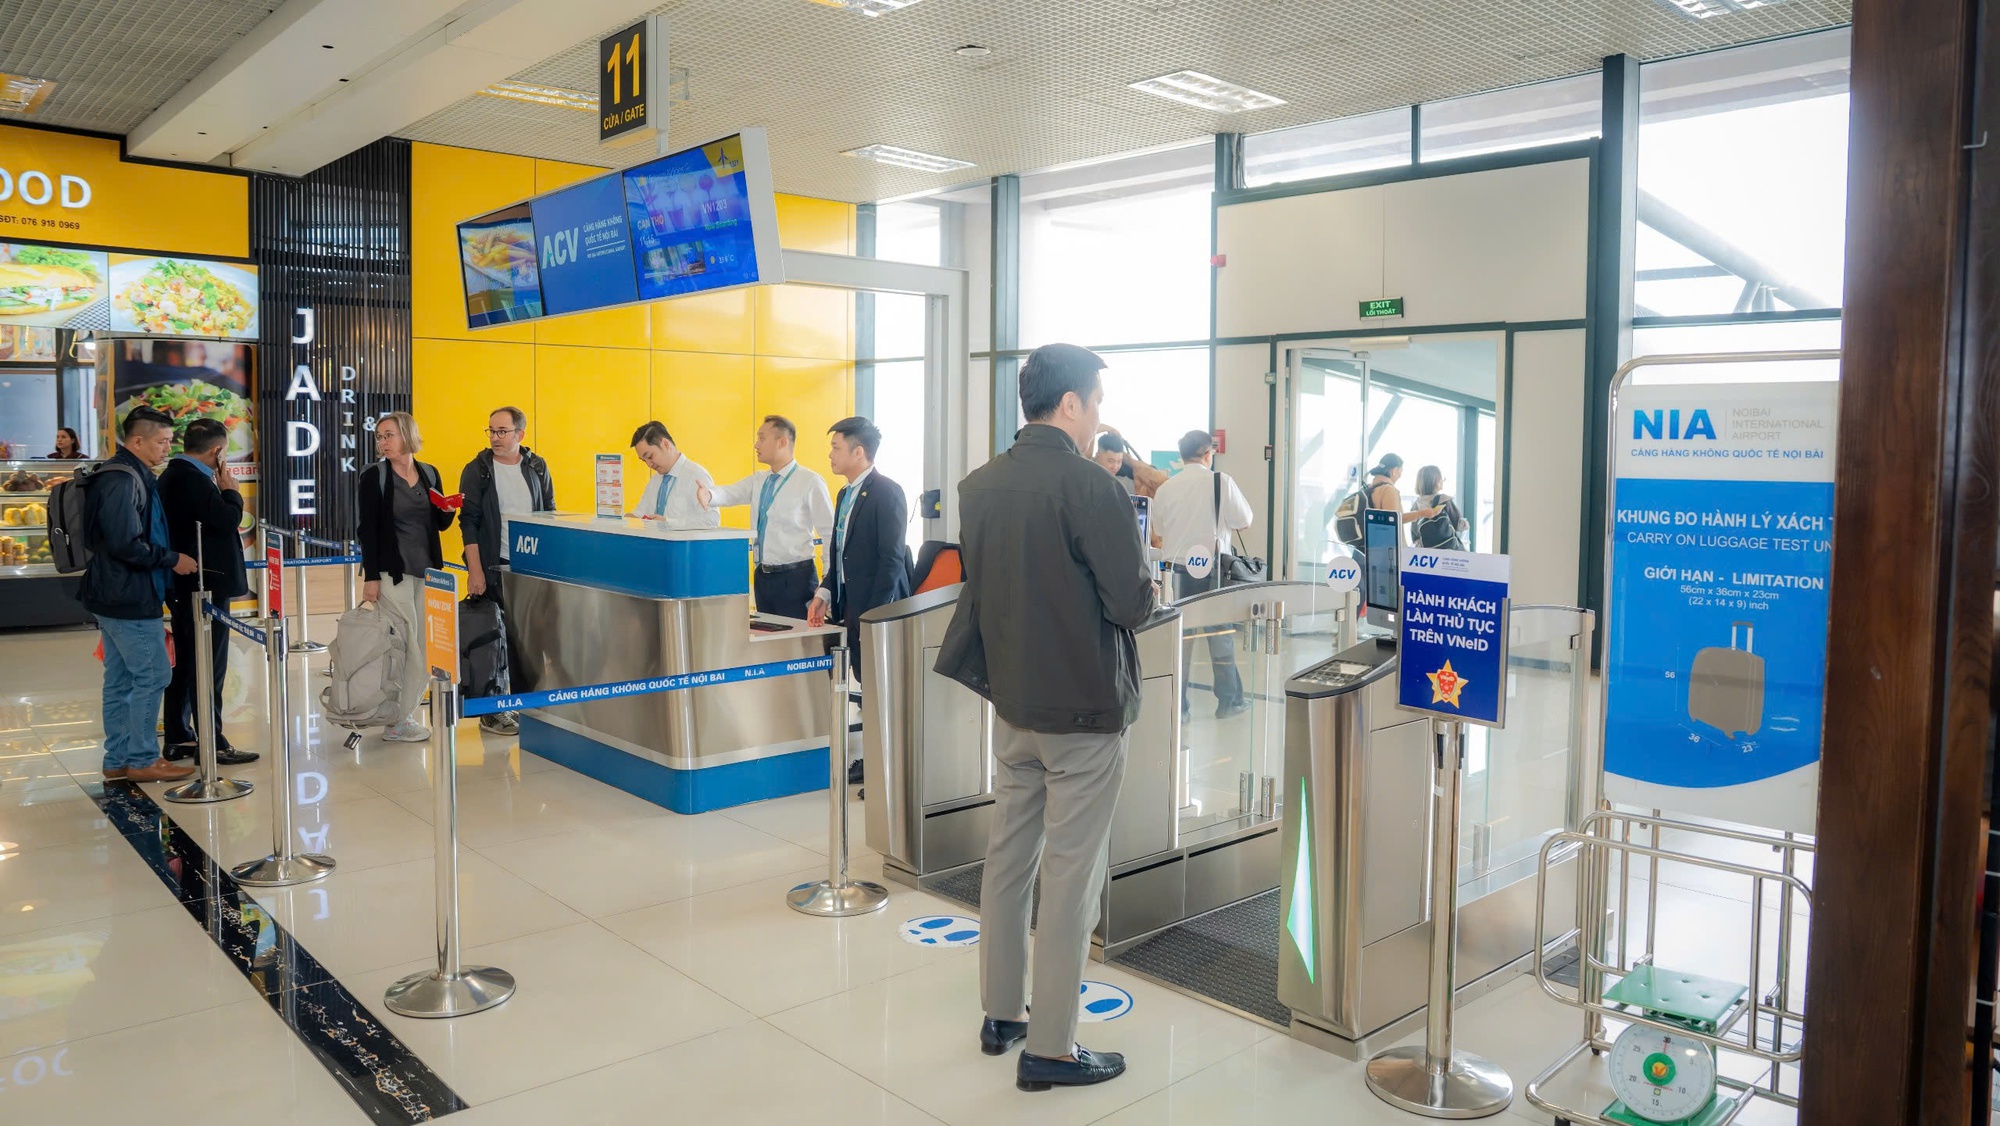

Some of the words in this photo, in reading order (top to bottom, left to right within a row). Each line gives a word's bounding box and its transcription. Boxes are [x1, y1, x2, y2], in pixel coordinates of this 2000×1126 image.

[607, 33, 640, 105] 11
[624, 103, 645, 122] GATE
[702, 199, 728, 215] VN1203
[21, 217, 38, 227] 076
[41, 219, 56, 229] 918
[58, 220, 80, 230] 0969
[541, 226, 579, 270] ACV
[1370, 300, 1391, 309] EXIT
[285, 307, 321, 515] JADE
[341, 365, 357, 473] DRINK
[1732, 408, 1771, 418] NOIBAI
[362, 415, 376, 432] &
[1633, 409, 1717, 440] NIA
[1732, 419, 1824, 429] INTERNATIONAL
[1731, 431, 1782, 441] AIRPORT
[1692, 446, 1730, 458] KHÔNG
[1617, 509, 1671, 525] KHUNG
[1674, 511, 1698, 526] ĐO
[1701, 509, 1747, 528] HÀNH
[1751, 510, 1772, 529] LÝ
[1775, 512, 1824, 531] XÁCH
[515, 534, 539, 556] ACV
[1627, 531, 1673, 545] CARRY
[1675, 533, 1696, 546] ON
[1699, 535, 1769, 550] LUGGAGE
[1772, 538, 1810, 551] TEST
[1188, 556, 1209, 567] ACV
[1409, 554, 1439, 569] ACV
[1328, 568, 1357, 580] ACV
[1643, 564, 1677, 580] GIỚI
[1681, 569, 1714, 585] HẠN
[1732, 572, 1824, 590] LIMITATION
[1680, 584, 1706, 595] 56cm
[1715, 586, 1742, 597] 36cm
[1752, 590, 1780, 600] 23cm
[1406, 590, 1445, 607] HÀNH
[1447, 596, 1496, 614] KHÁCH
[1688, 596, 1704, 606] (22
[1715, 597, 1726, 607] 14
[1736, 599, 1747, 610] 9)
[1749, 600, 1769, 611] inch
[427, 614, 434, 642] 1
[1406, 608, 1434, 624] LÀM
[1437, 613, 1464, 629] THỦ
[1467, 618, 1495, 635] TỤC
[1410, 628, 1443, 645] TRÊN
[1447, 634, 1489, 652] VNeID
[744, 668, 765, 677] N.I.A
[786, 661, 815, 671] NOIBAI
[612, 682, 646, 694] KHÔNG
[648, 676, 676, 689] QUỐC
[678, 671, 690, 685] TẾ
[691, 672, 708, 686] NỘI
[1665, 671, 1675, 679] 56
[497, 698, 523, 709] N.I.A
[1688, 732, 1700, 743] 36
[1742, 744, 1753, 754] 23
[1652, 1098, 1660, 1106] 15
